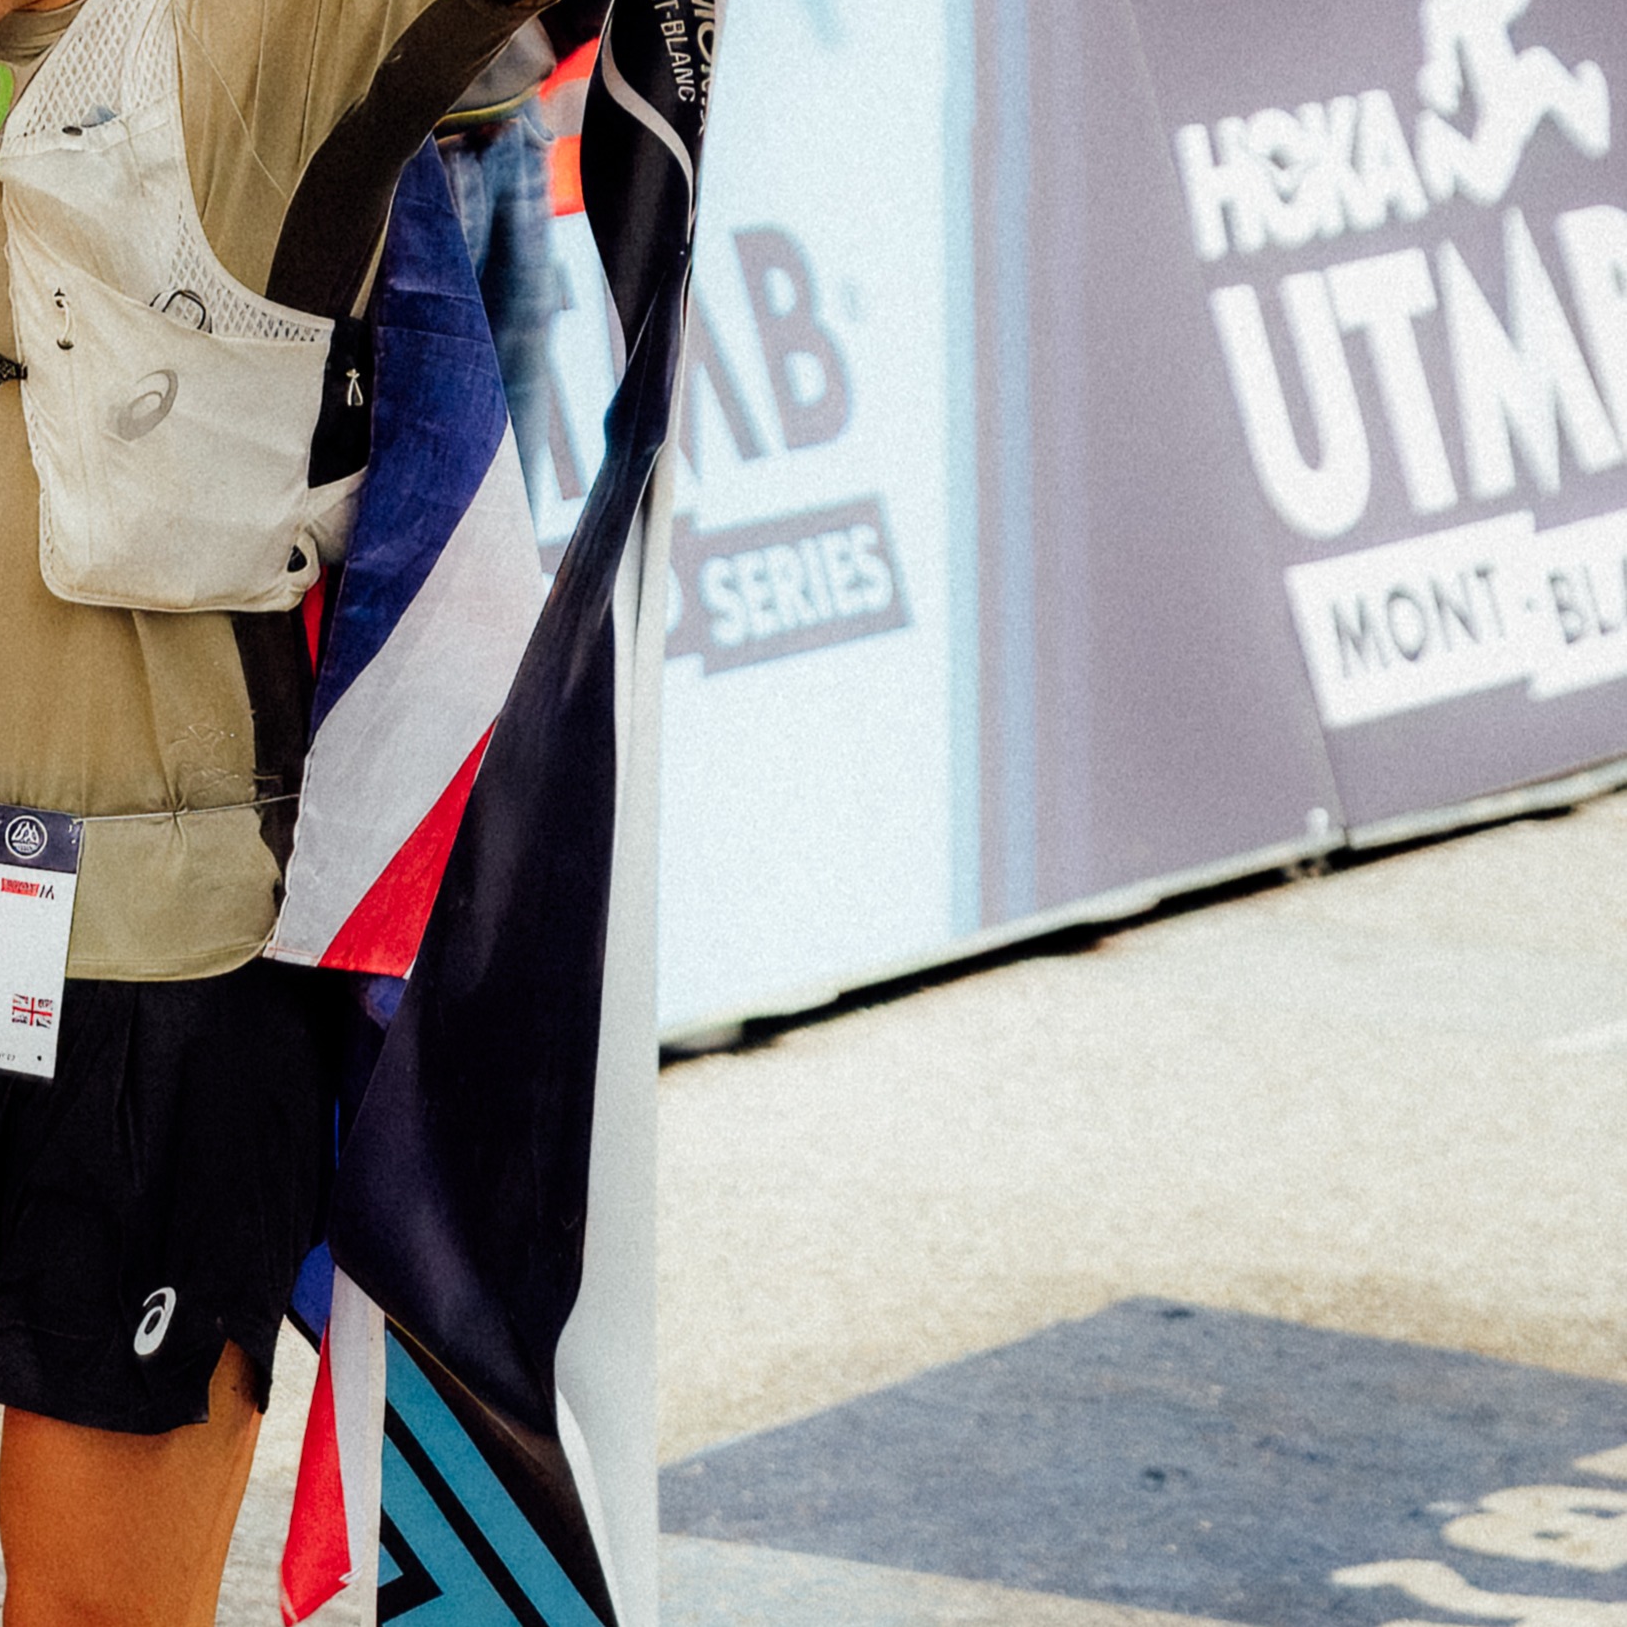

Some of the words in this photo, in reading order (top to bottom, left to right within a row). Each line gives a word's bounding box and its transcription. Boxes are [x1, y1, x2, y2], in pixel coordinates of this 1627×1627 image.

[1174, 88, 1430, 261] HOKA
[699, 524, 894, 646] SERIES
[1329, 557, 1627, 681] MONT-BL
